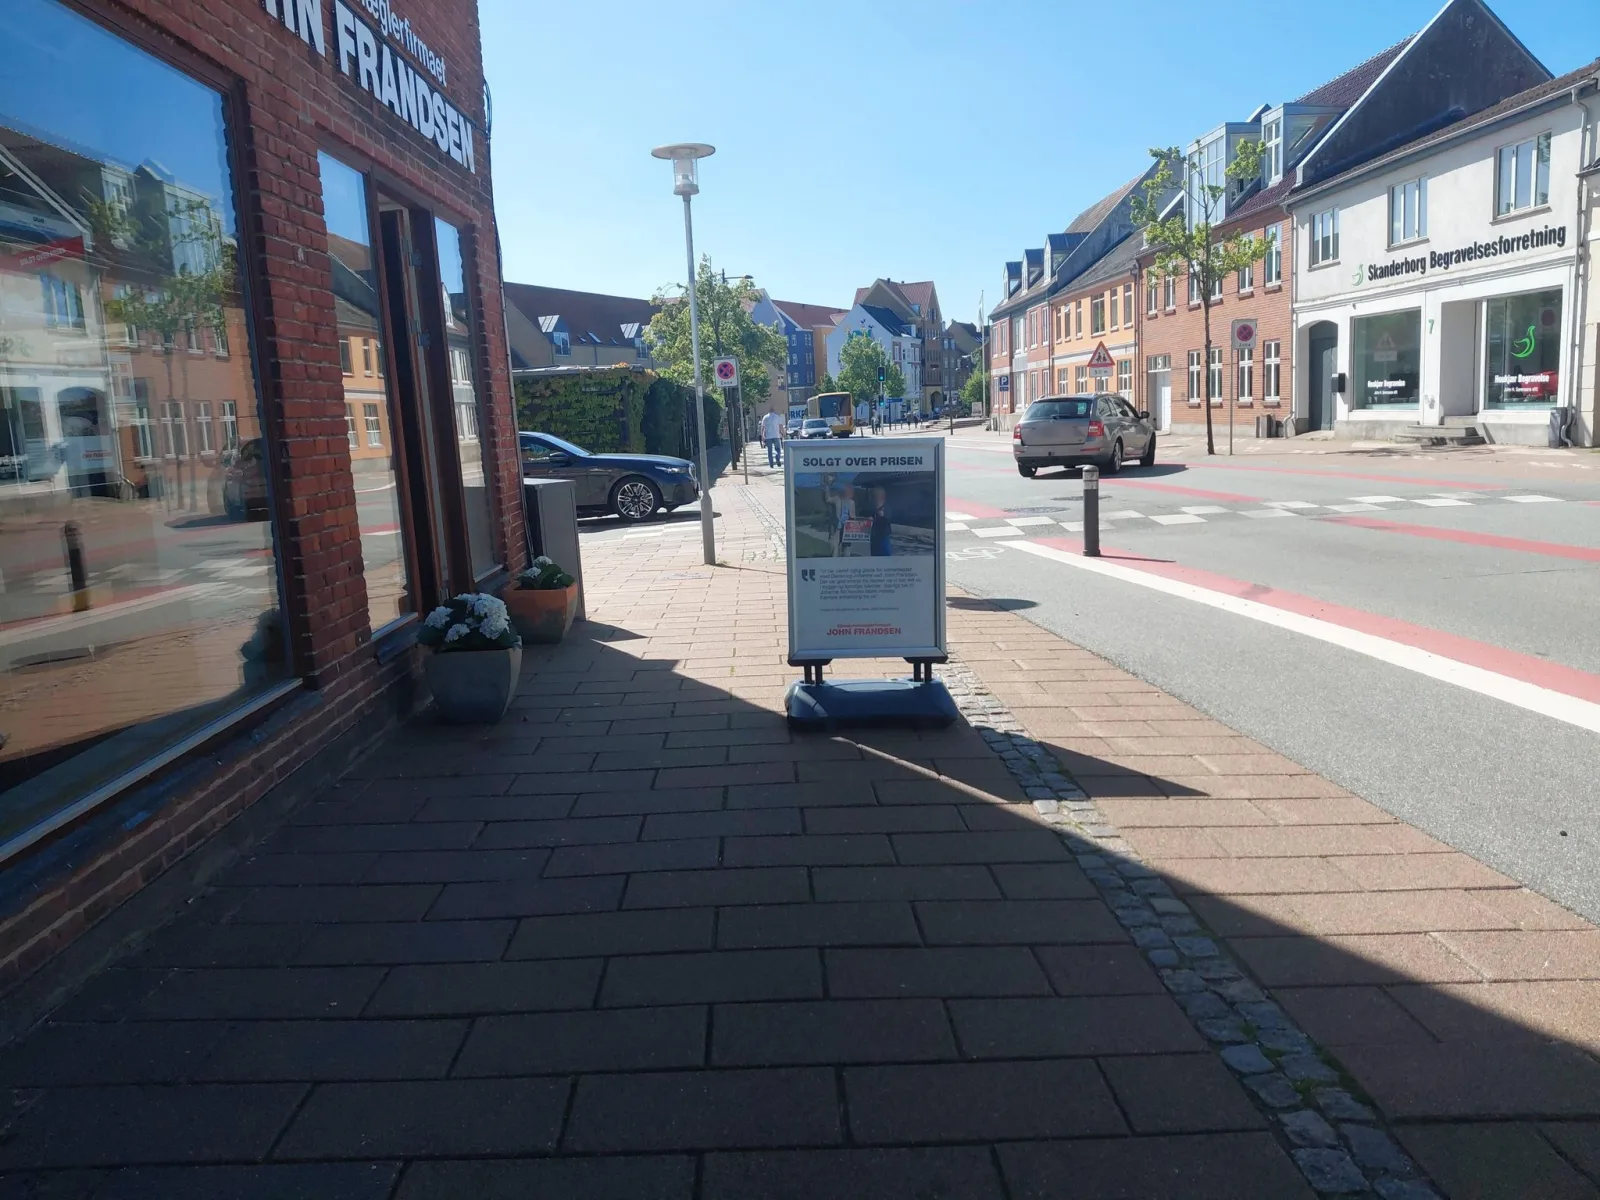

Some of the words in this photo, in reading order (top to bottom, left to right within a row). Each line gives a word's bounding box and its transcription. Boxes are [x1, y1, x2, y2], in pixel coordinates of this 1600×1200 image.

[334, 0, 476, 175] FRANDSEN
[1368, 256, 1426, 281] Skanderborg
[1429, 225, 1567, 270] Begravelsesforretning
[1428, 319, 1435, 334] 7
[1157, 356, 1162, 369] 5
[1001, 376, 1007, 385] P
[803, 457, 841, 467] SOLGT
[845, 456, 877, 466] OVER
[880, 456, 923, 466] PRISEN
[826, 627, 851, 636] JOHN
[853, 627, 902, 636] FRANDSEN
